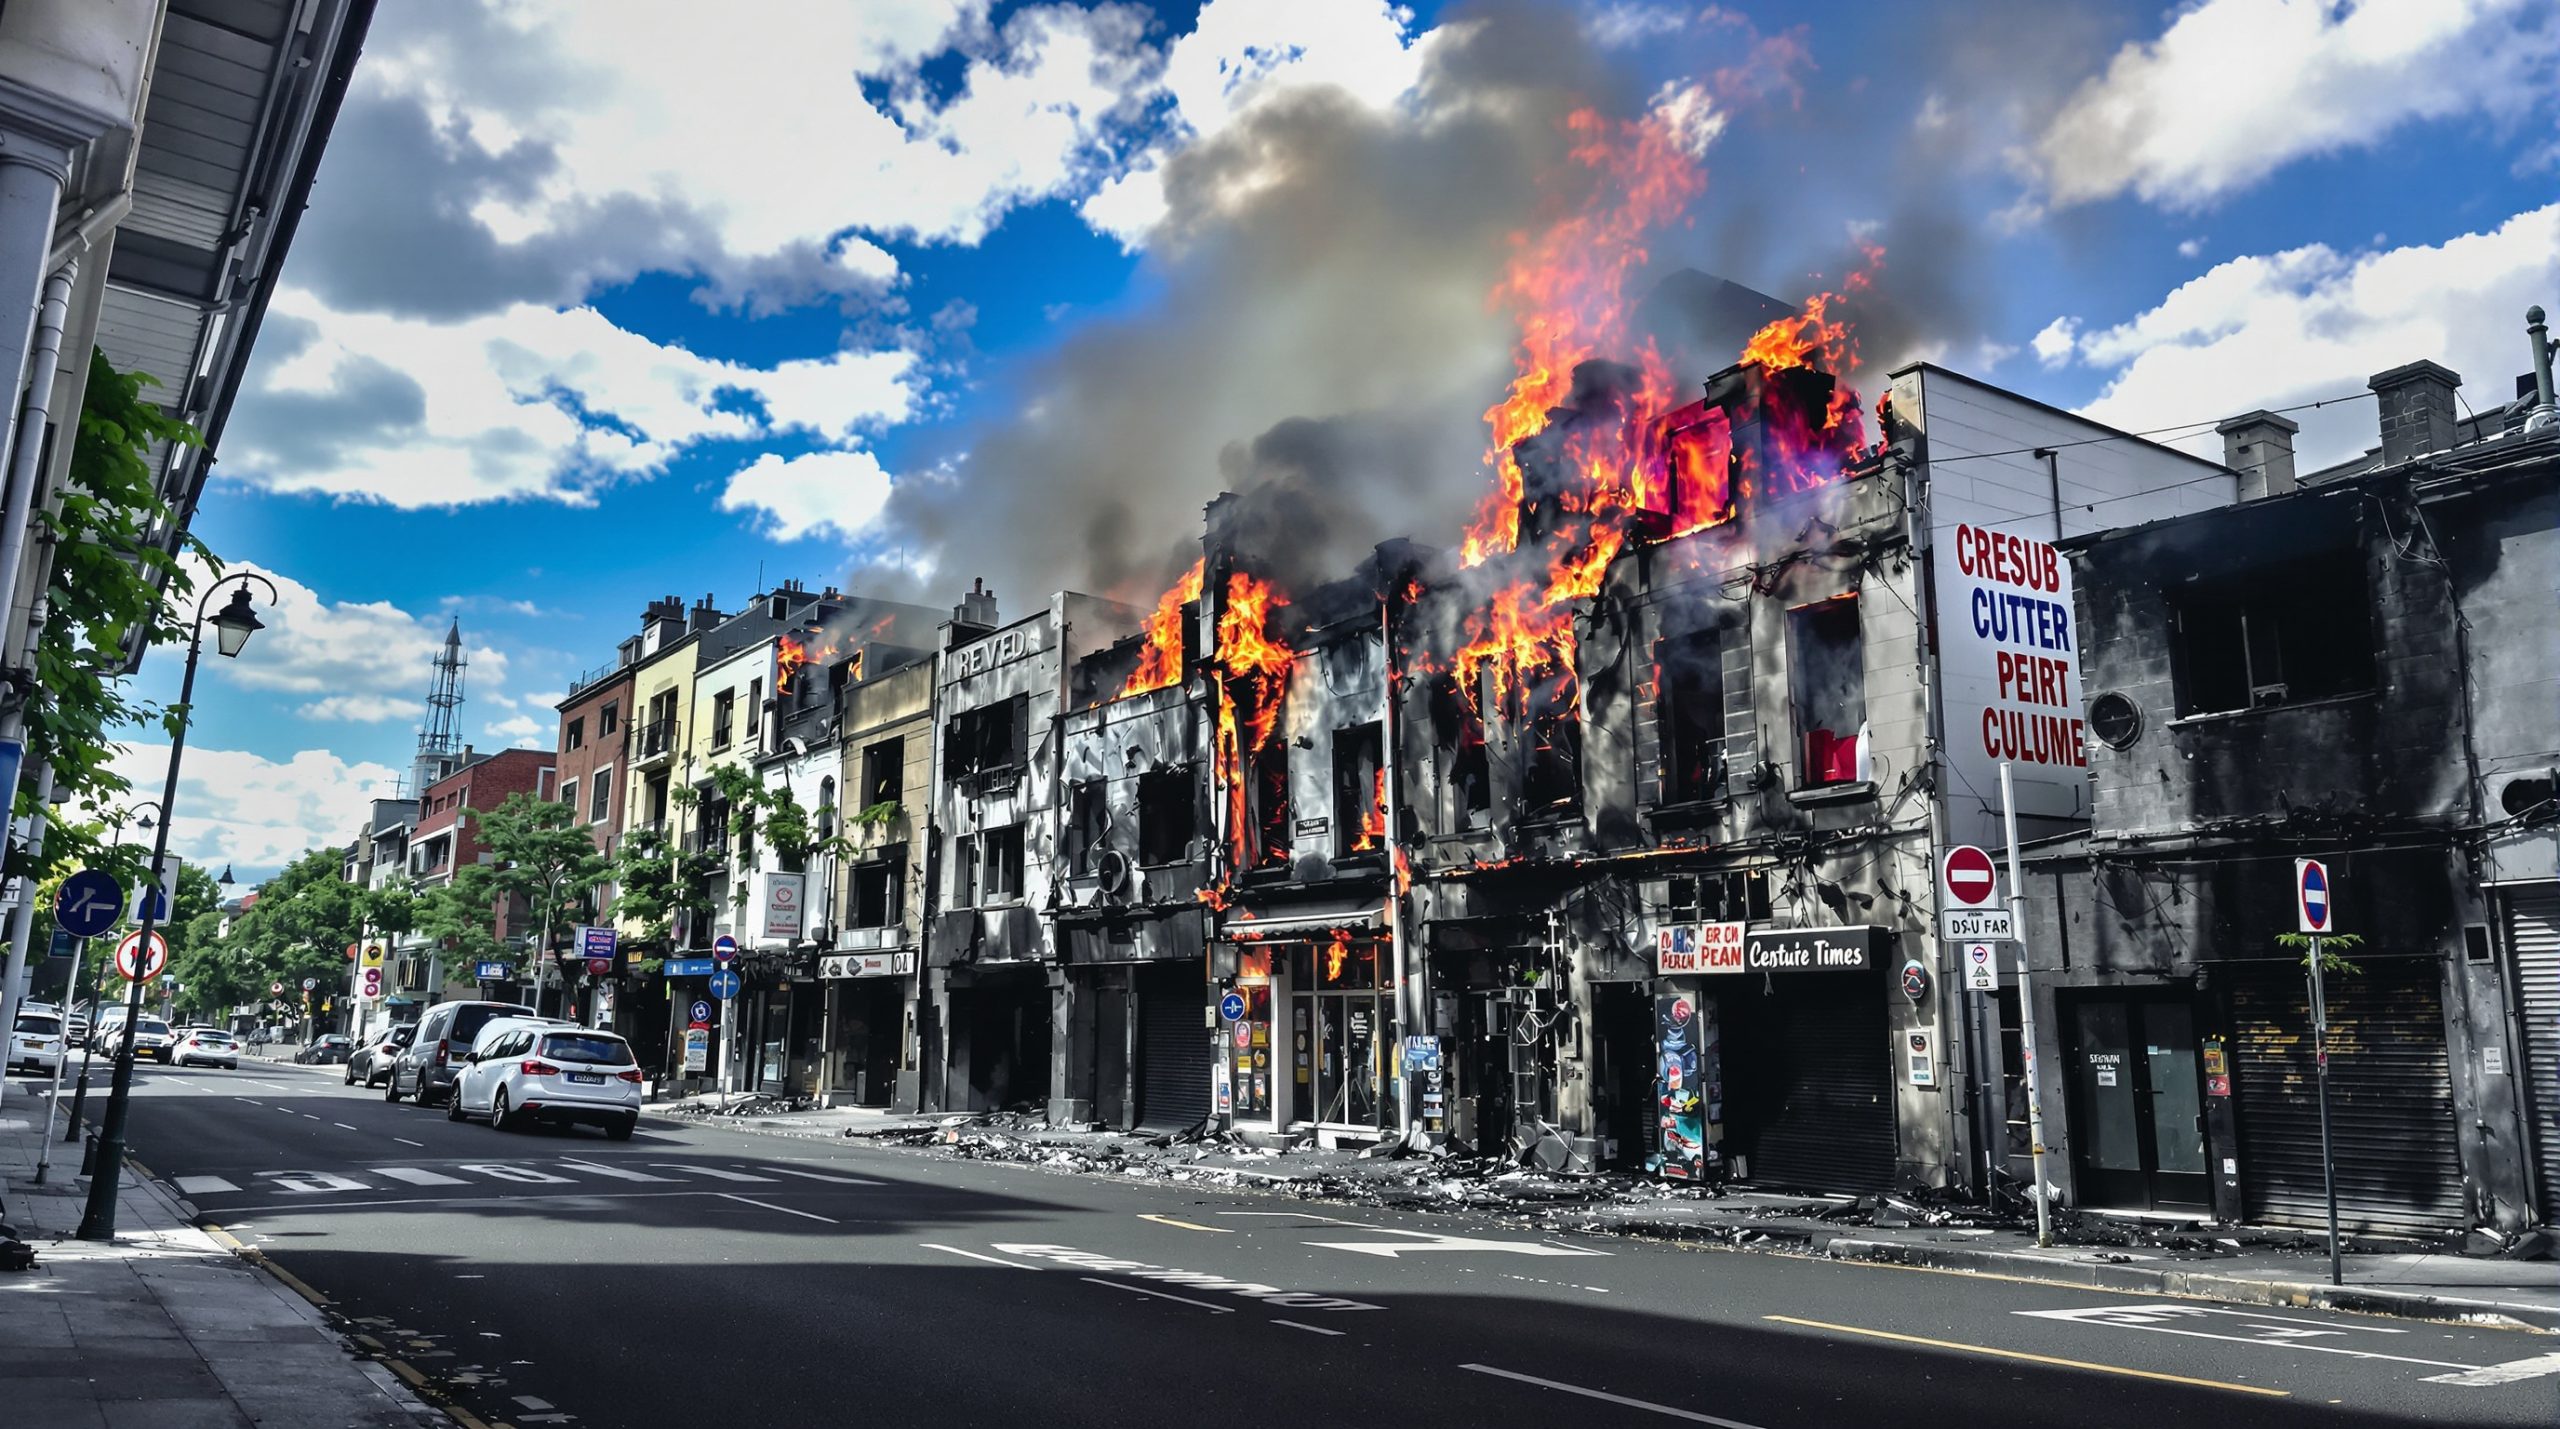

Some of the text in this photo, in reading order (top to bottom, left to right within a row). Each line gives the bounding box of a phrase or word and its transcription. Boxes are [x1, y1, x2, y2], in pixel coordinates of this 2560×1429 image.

[1957, 523, 2060, 593] CRESUB
[1972, 587, 2071, 652] CUTTER
[1997, 650, 2068, 708] PEIRT
[1983, 707, 2087, 767] CULUME
[1814, 940, 1863, 965] Times
[1984, 919, 2009, 934] FAR
[1701, 946, 1742, 966] PEAN
